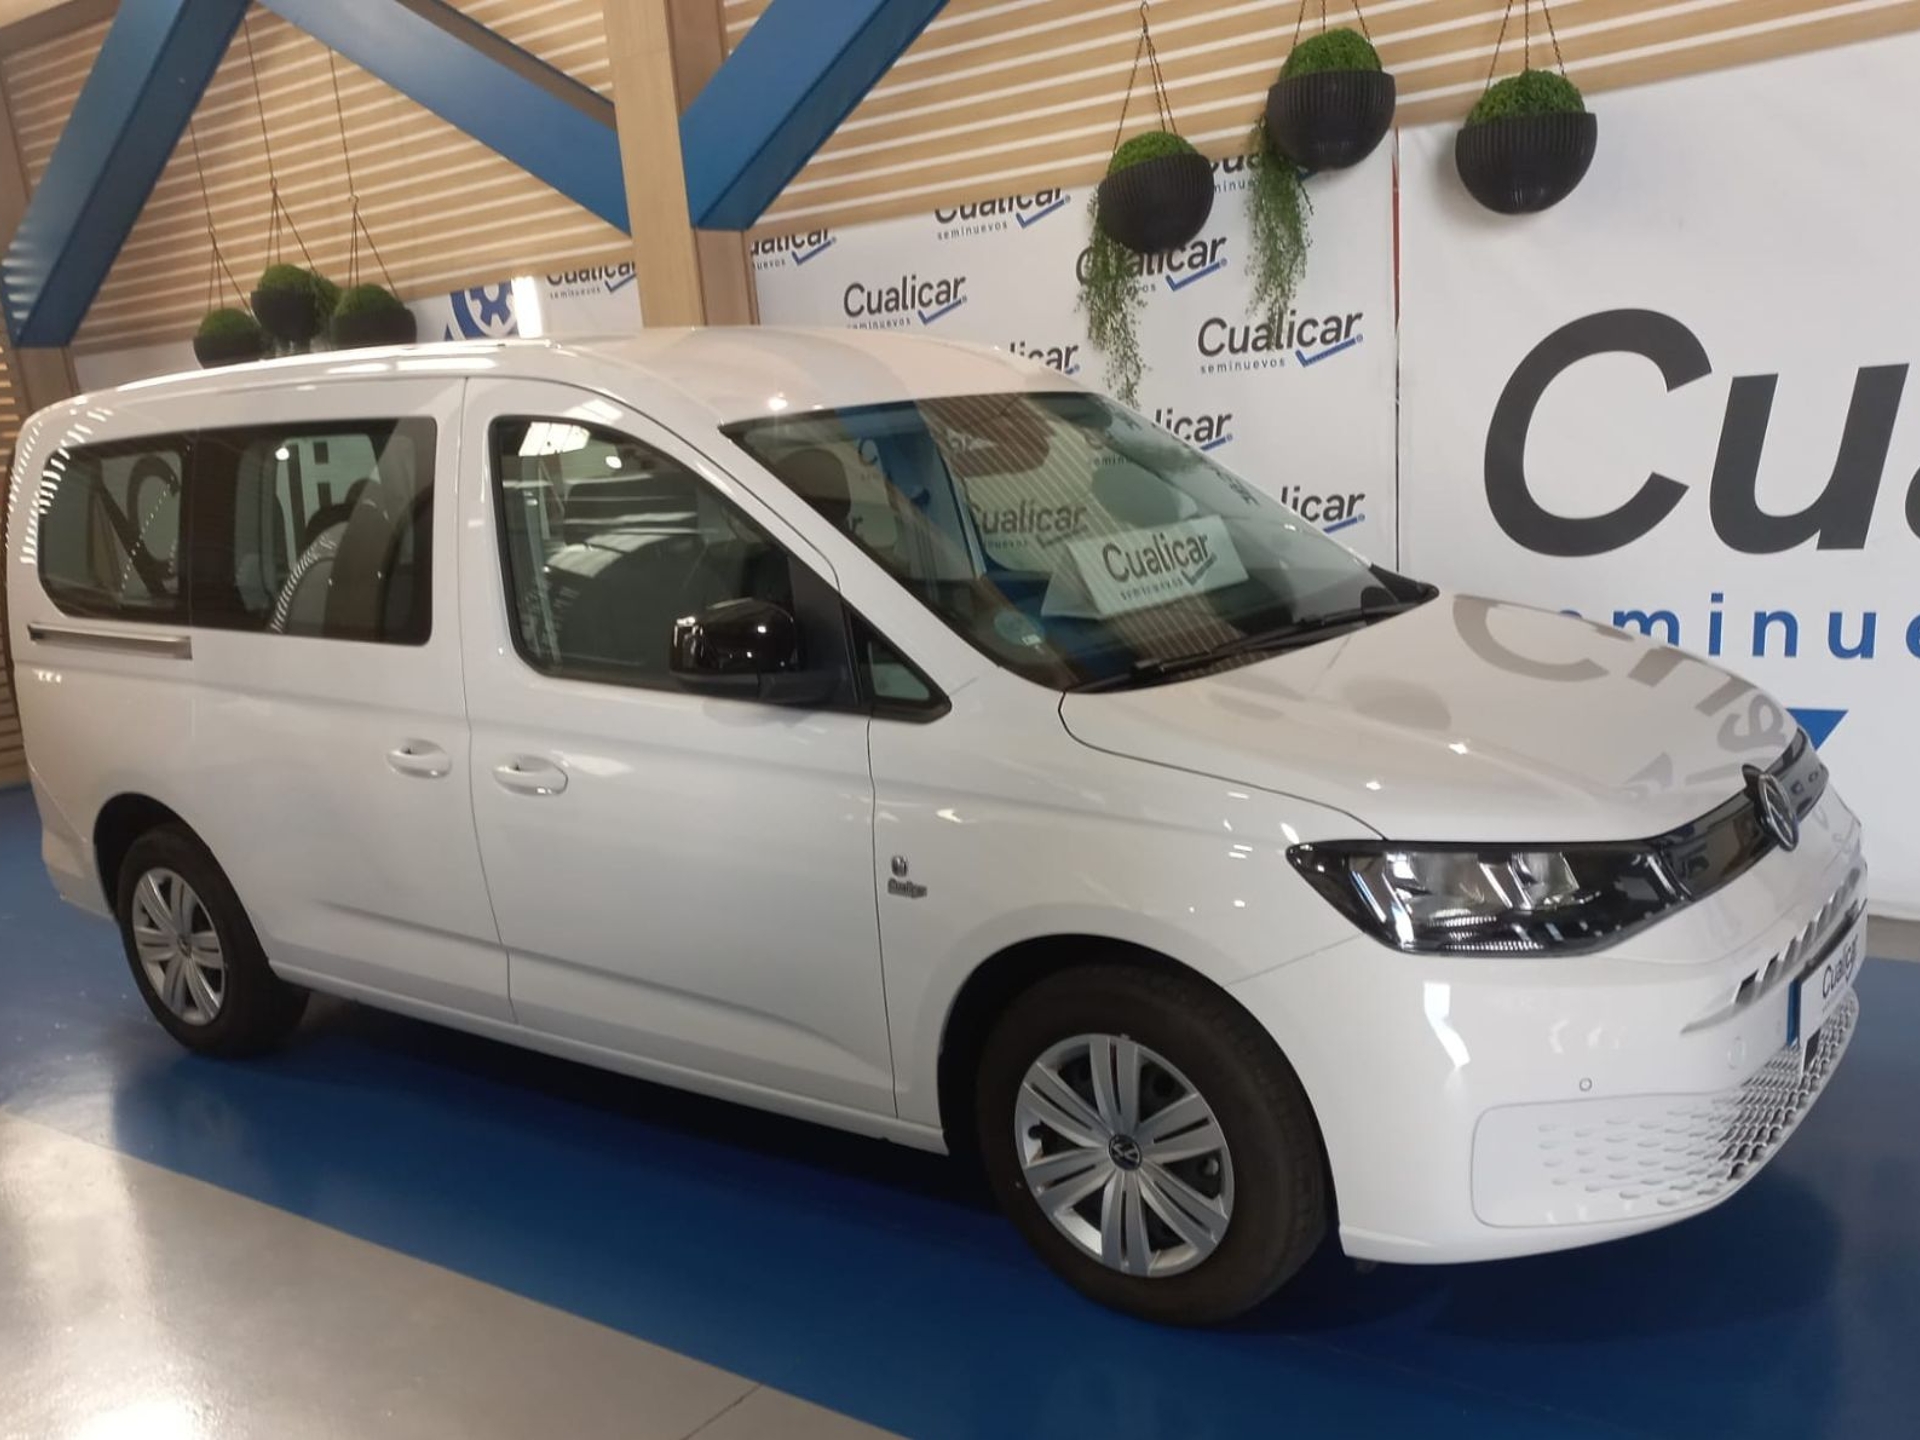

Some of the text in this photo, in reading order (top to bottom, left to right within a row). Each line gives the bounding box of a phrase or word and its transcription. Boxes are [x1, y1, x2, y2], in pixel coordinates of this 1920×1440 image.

[843, 274, 966, 318] Cualicar
[1197, 309, 1364, 358] Cualicar
[1200, 357, 1285, 374] seminuevos
[1484, 308, 1920, 557] Cu
[968, 498, 1088, 534] ualicar
[1102, 532, 1208, 583] Cualicar
[1557, 592, 1920, 659] minu
